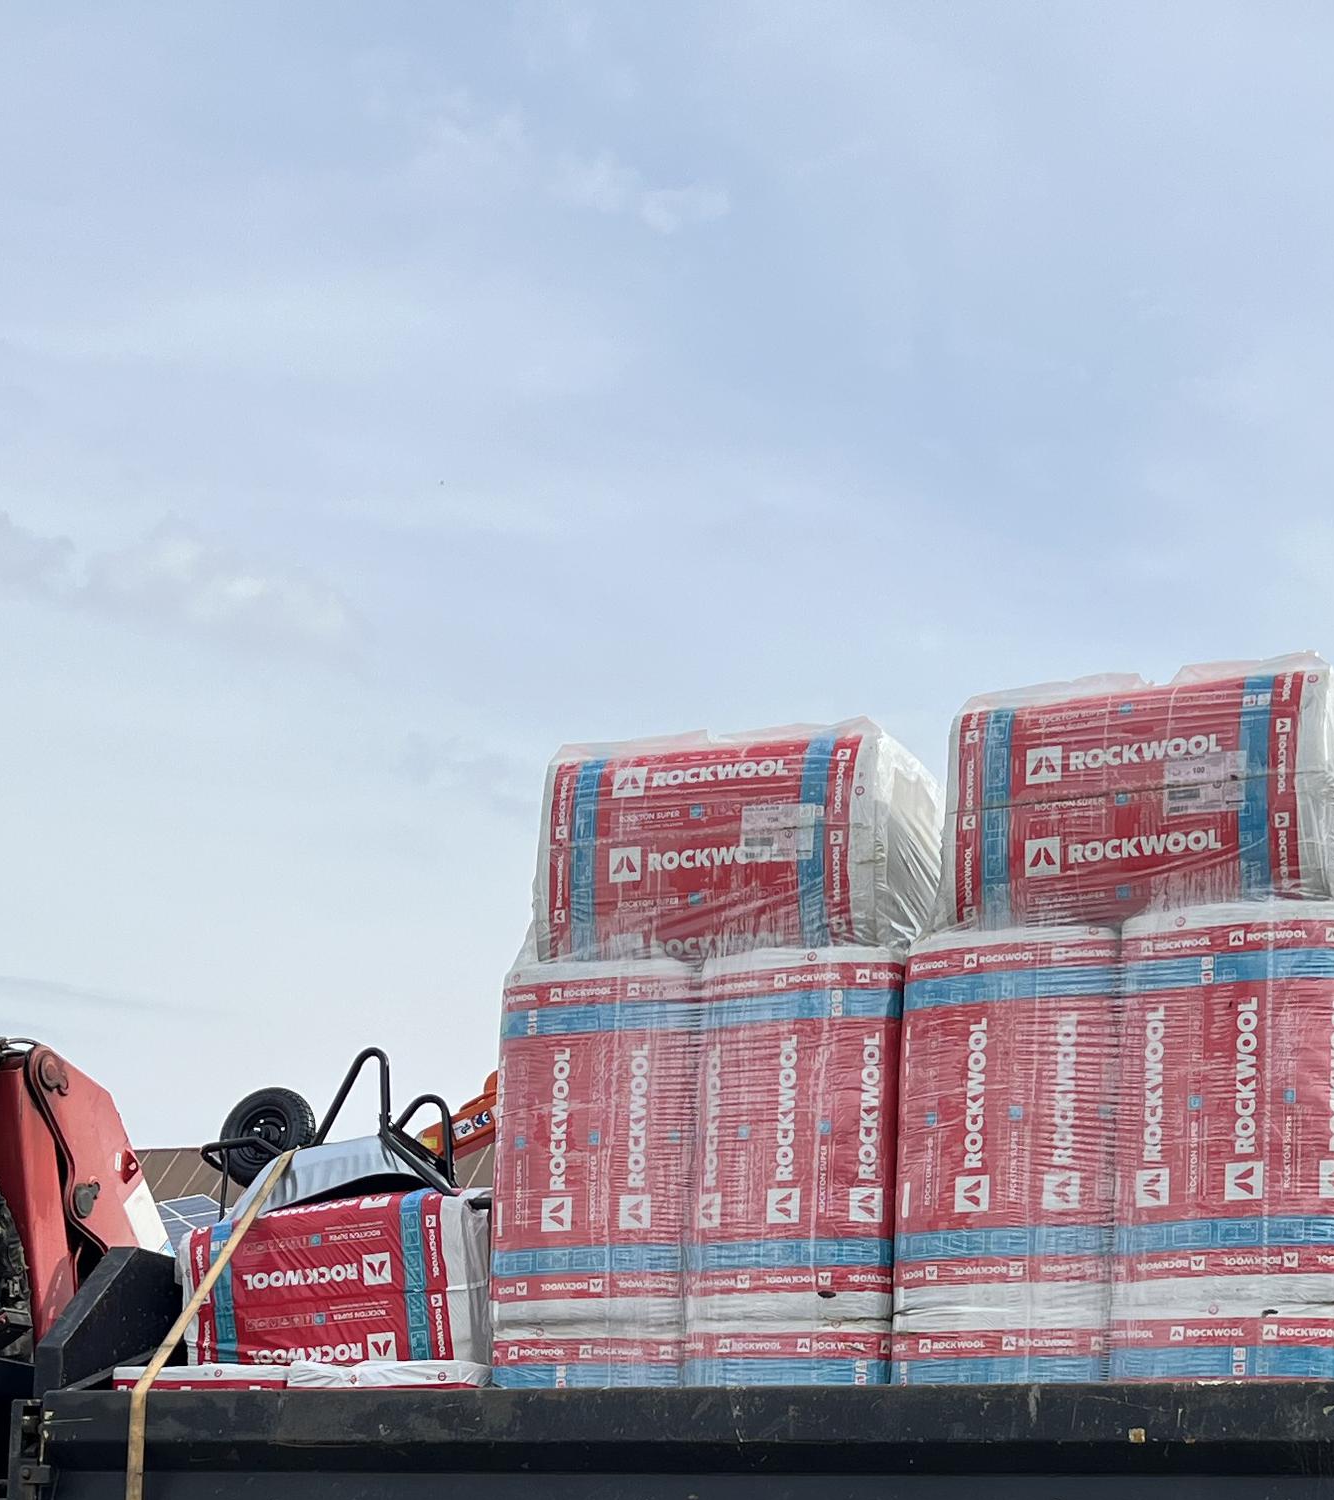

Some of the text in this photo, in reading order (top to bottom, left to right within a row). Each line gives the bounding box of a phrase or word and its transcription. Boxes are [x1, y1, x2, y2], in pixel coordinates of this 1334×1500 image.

[1069, 734, 1222, 771] ROCKWOOL
[652, 759, 789, 788] ROCKWOOL
[1068, 829, 1221, 864] ROCKWOOL
[1246, 929, 1308, 941] ROCKWOOL
[979, 951, 1034, 963] ROCKWOOL
[1143, 1006, 1165, 1162] ROCKWOOL
[1235, 996, 1258, 1154] ROCKWOOL
[775, 1034, 798, 1181] ROCKWOOL
[858, 1032, 879, 1180] ROCKWOOL
[964, 1017, 987, 1169] ROCKWOOL
[549, 1047, 570, 1191] ROCKWOOL
[628, 1043, 649, 1188] ROCKWOOL
[427, 1229, 439, 1278] ROCKWOOL
[1224, 1255, 1282, 1265] ROCKWOOL
[242, 1261, 358, 1290] ROCKWOOL
[333, 1309, 386, 1321] ROCKTON SUPER
[1185, 1327, 1244, 1338] ROCKWOOL
[435, 1309, 446, 1357] ROCKWOOL
[932, 1340, 985, 1349] ROCKWOOL
[247, 1342, 363, 1364] ROCKWOOL
[519, 1348, 565, 1357] ROCKWOOL
